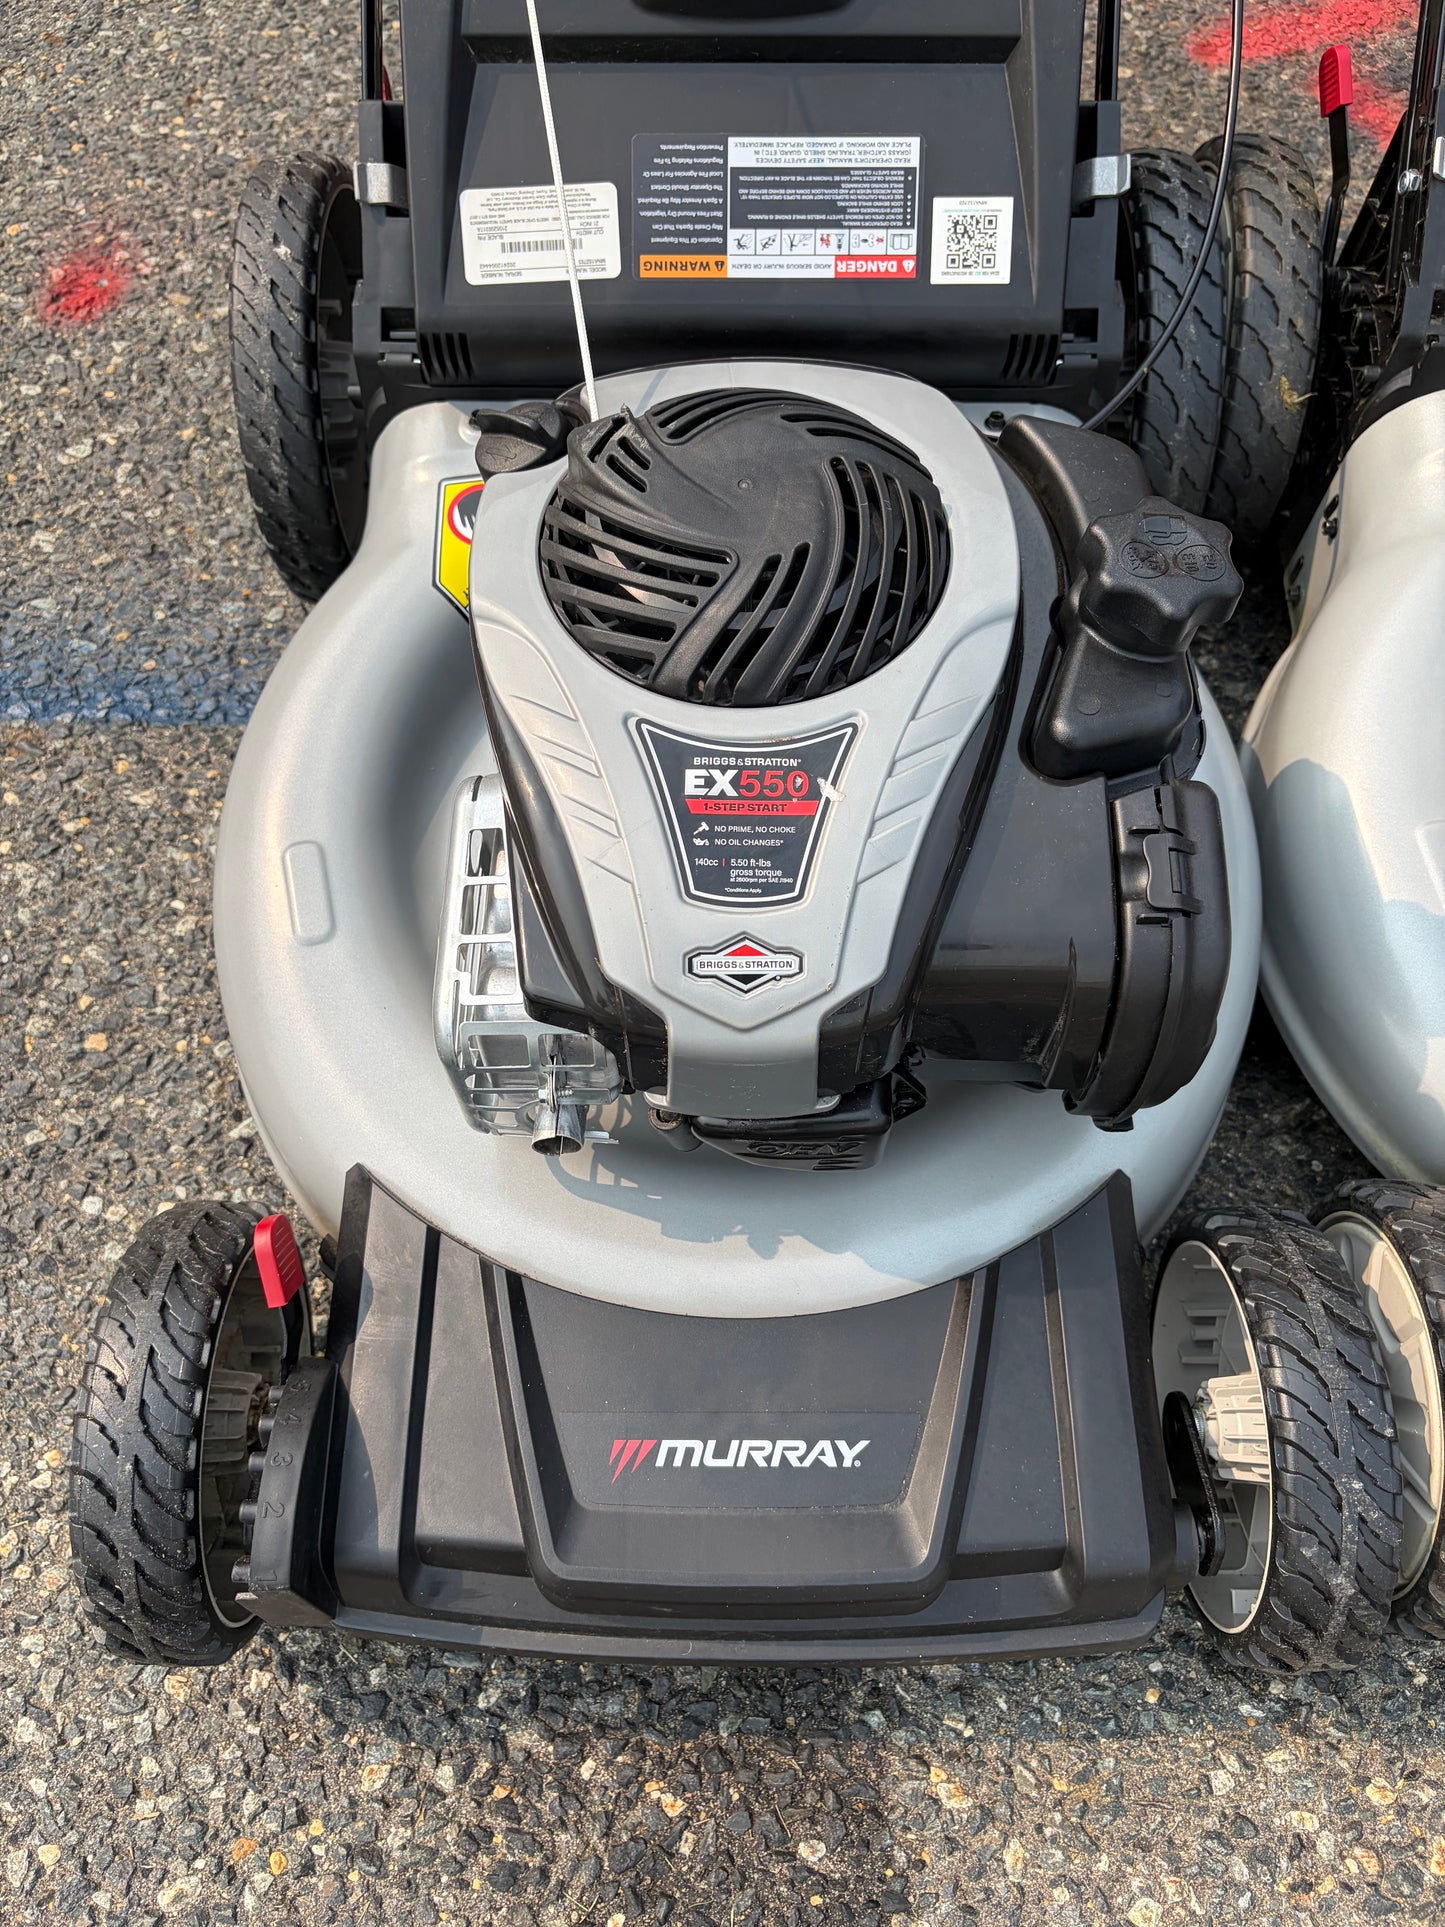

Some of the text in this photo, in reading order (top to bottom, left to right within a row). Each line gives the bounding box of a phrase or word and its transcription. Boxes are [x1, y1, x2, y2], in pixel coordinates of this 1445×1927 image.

[643, 261, 710, 271] WARNING
[836, 261, 898, 272] DANGER
[684, 768, 809, 798] EX550
[703, 803, 787, 812] 1-STEP START
[714, 825, 727, 833] NO
[728, 826, 754, 834] PRIME,
[769, 826, 796, 834] CHOKE
[694, 858, 772, 867] 140cc 5.50 ft-lbs
[730, 869, 782, 878] gross torque
[699, 960, 793, 969] BRIGGS&STRATTON
[271, 1452, 293, 1468] 3
[263, 1502, 285, 1518] 2
[256, 1570, 278, 1582] 1
